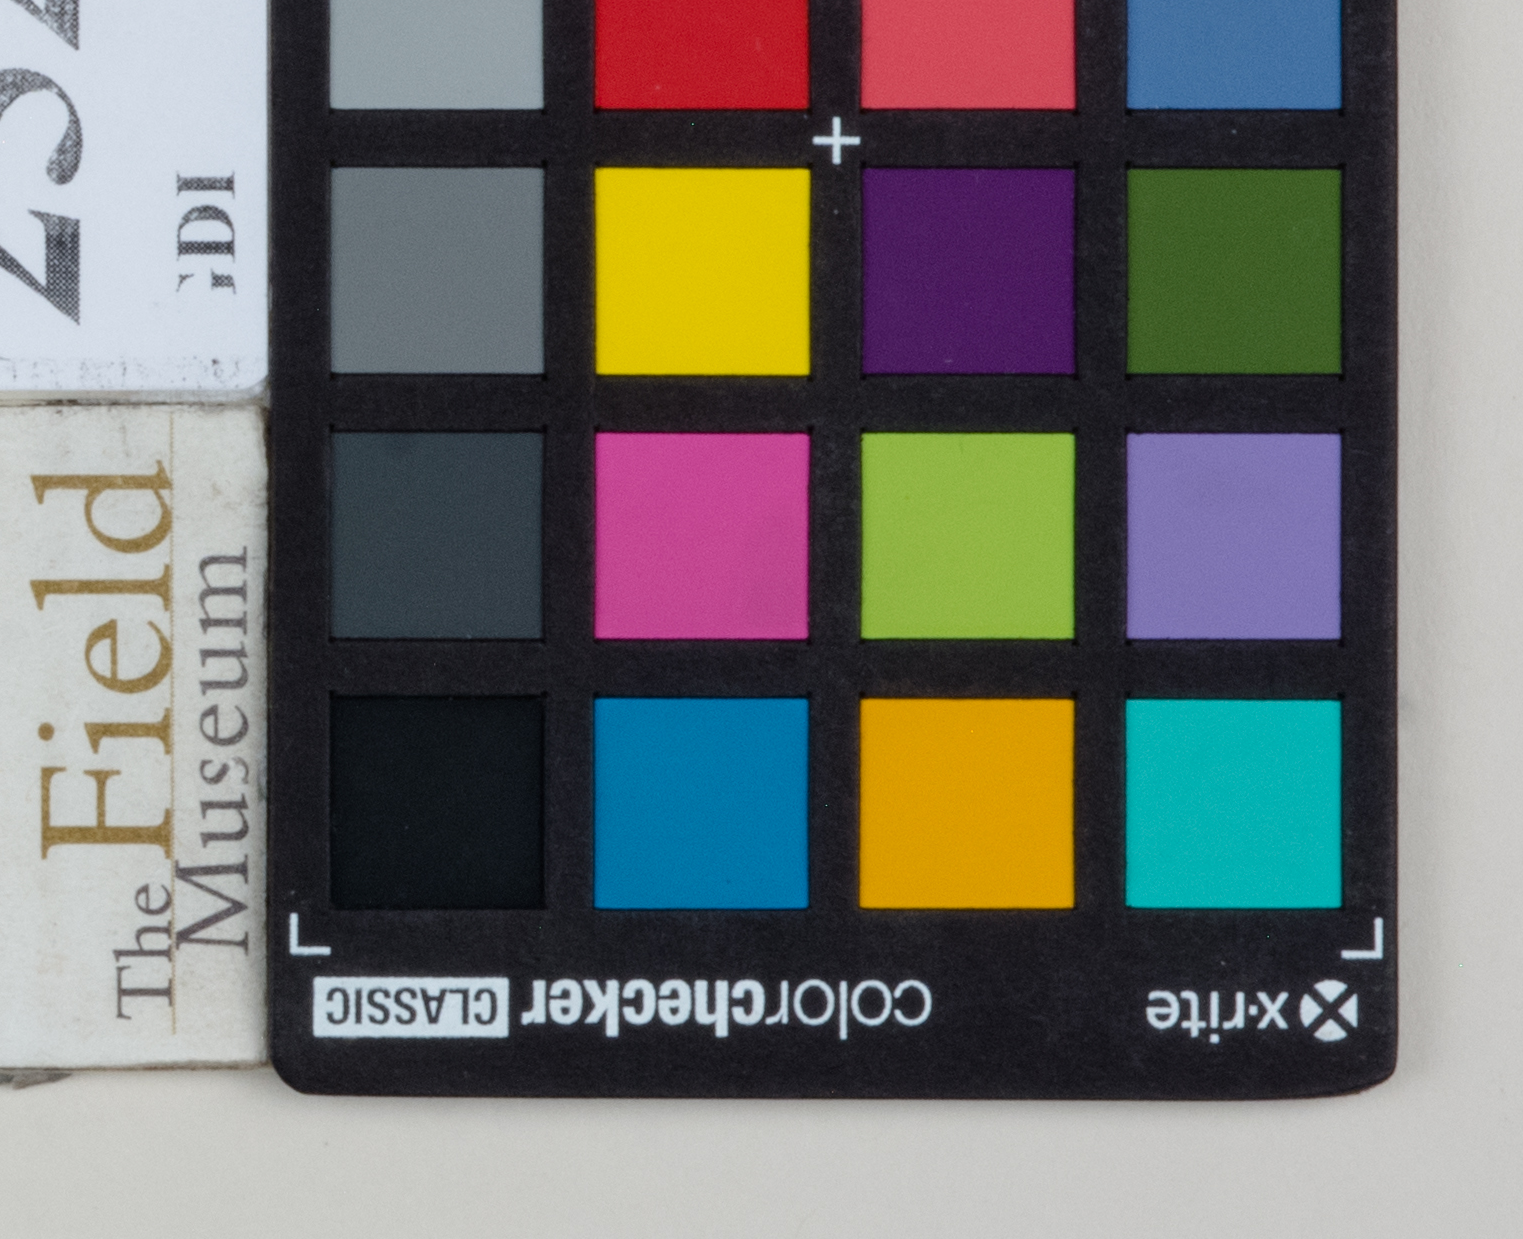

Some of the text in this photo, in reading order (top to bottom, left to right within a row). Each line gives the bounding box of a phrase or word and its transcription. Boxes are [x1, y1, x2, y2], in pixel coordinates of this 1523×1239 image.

[30, 460, 173, 1020] The Field
[174, 545, 249, 957] Museum
[324, 978, 933, 1040] colorchecker CLASSIC
